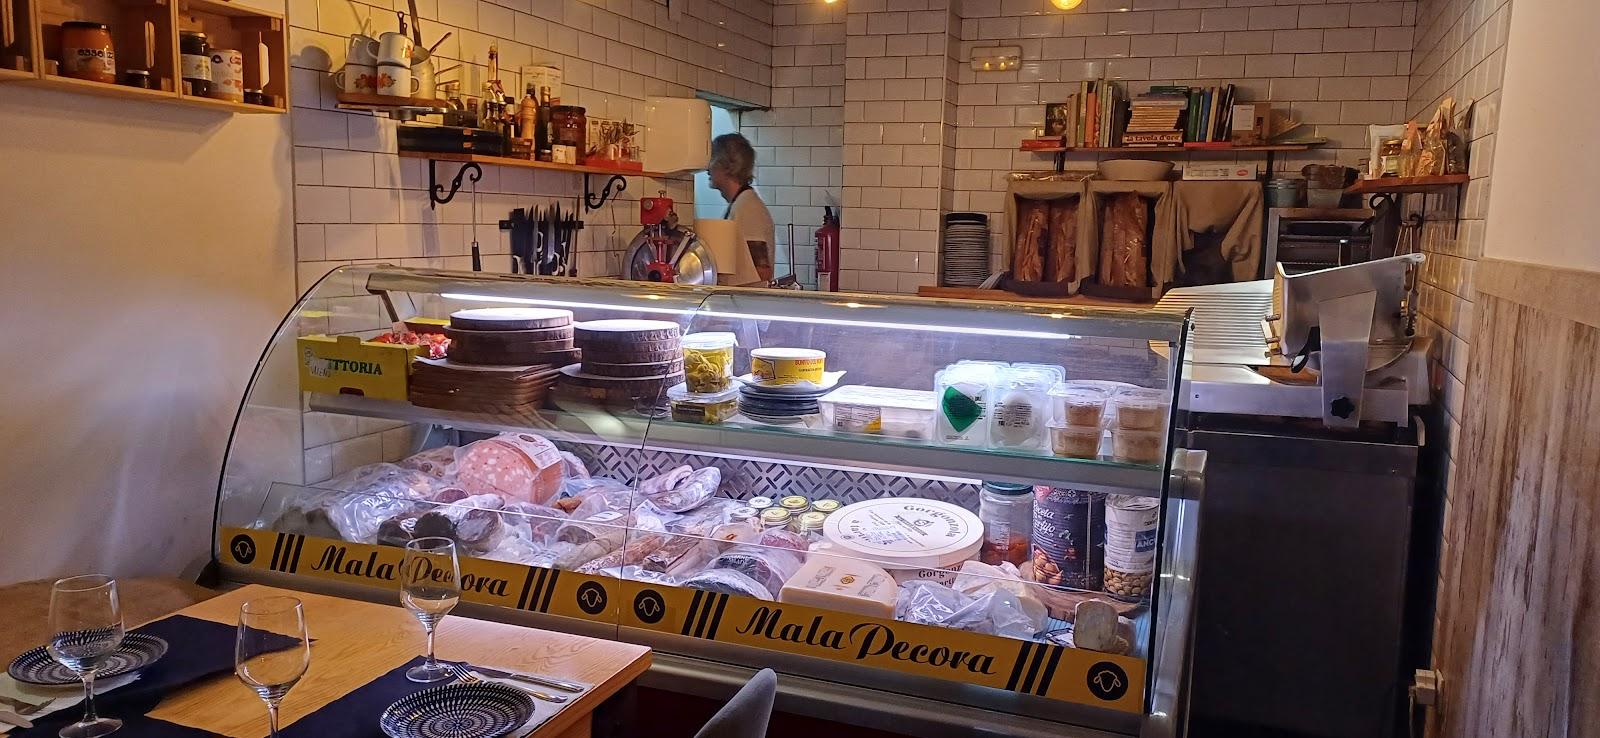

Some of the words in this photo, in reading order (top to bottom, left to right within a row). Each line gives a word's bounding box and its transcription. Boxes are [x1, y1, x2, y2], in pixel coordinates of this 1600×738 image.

[322, 358, 383, 376] ITTORIA
[903, 505, 961, 538] Gorgonzola
[311, 545, 396, 581] Mala
[399, 556, 510, 597] Pecora
[735, 606, 847, 650] Mala
[849, 622, 997, 675] Pecora
